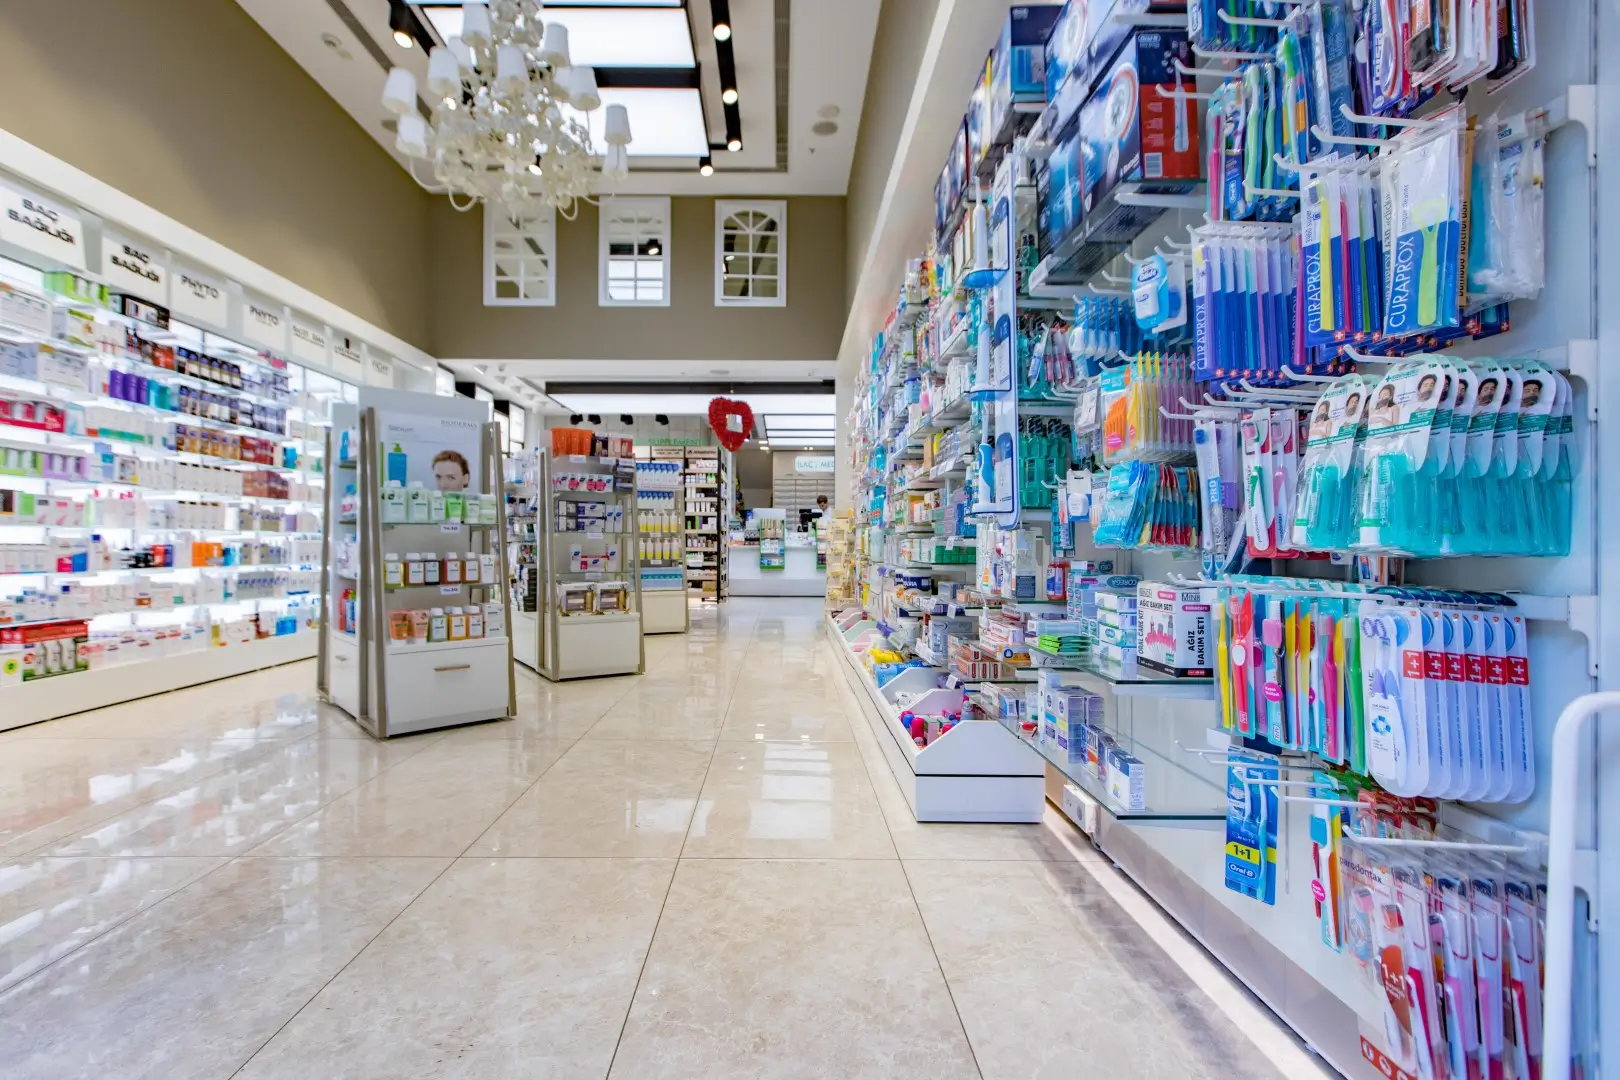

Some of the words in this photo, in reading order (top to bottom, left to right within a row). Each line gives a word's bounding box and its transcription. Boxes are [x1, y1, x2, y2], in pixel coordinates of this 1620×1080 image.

[22, 198, 59, 223] SAÇ
[7, 208, 75, 244] SAĞLIĞI
[122, 244, 150, 265] SAÇ
[111, 254, 160, 283] SAĞLIĞI
[181, 274, 219, 299] PHYTO
[1307, 250, 1321, 334] CURAPROX
[1390, 236, 1414, 328] CURAPROX
[1196, 302, 1207, 371] CURAPROX
[1209, 480, 1219, 504] PRO
[1196, 617, 1205, 635] SETİ
[1187, 630, 1195, 651] AĞIZ
[1197, 638, 1205, 665] BAKIM
[1406, 651, 1420, 677] 1+1
[1427, 652, 1441, 677] 1+1
[1447, 654, 1461, 679] 1+1
[1468, 655, 1482, 680] 1+1
[1488, 657, 1502, 682] 1+1
[1510, 657, 1524, 682] 1+1
[1233, 844, 1251, 860] 1+1
[1230, 863, 1254, 877] Oral-B
[1381, 963, 1405, 990] 1+1
